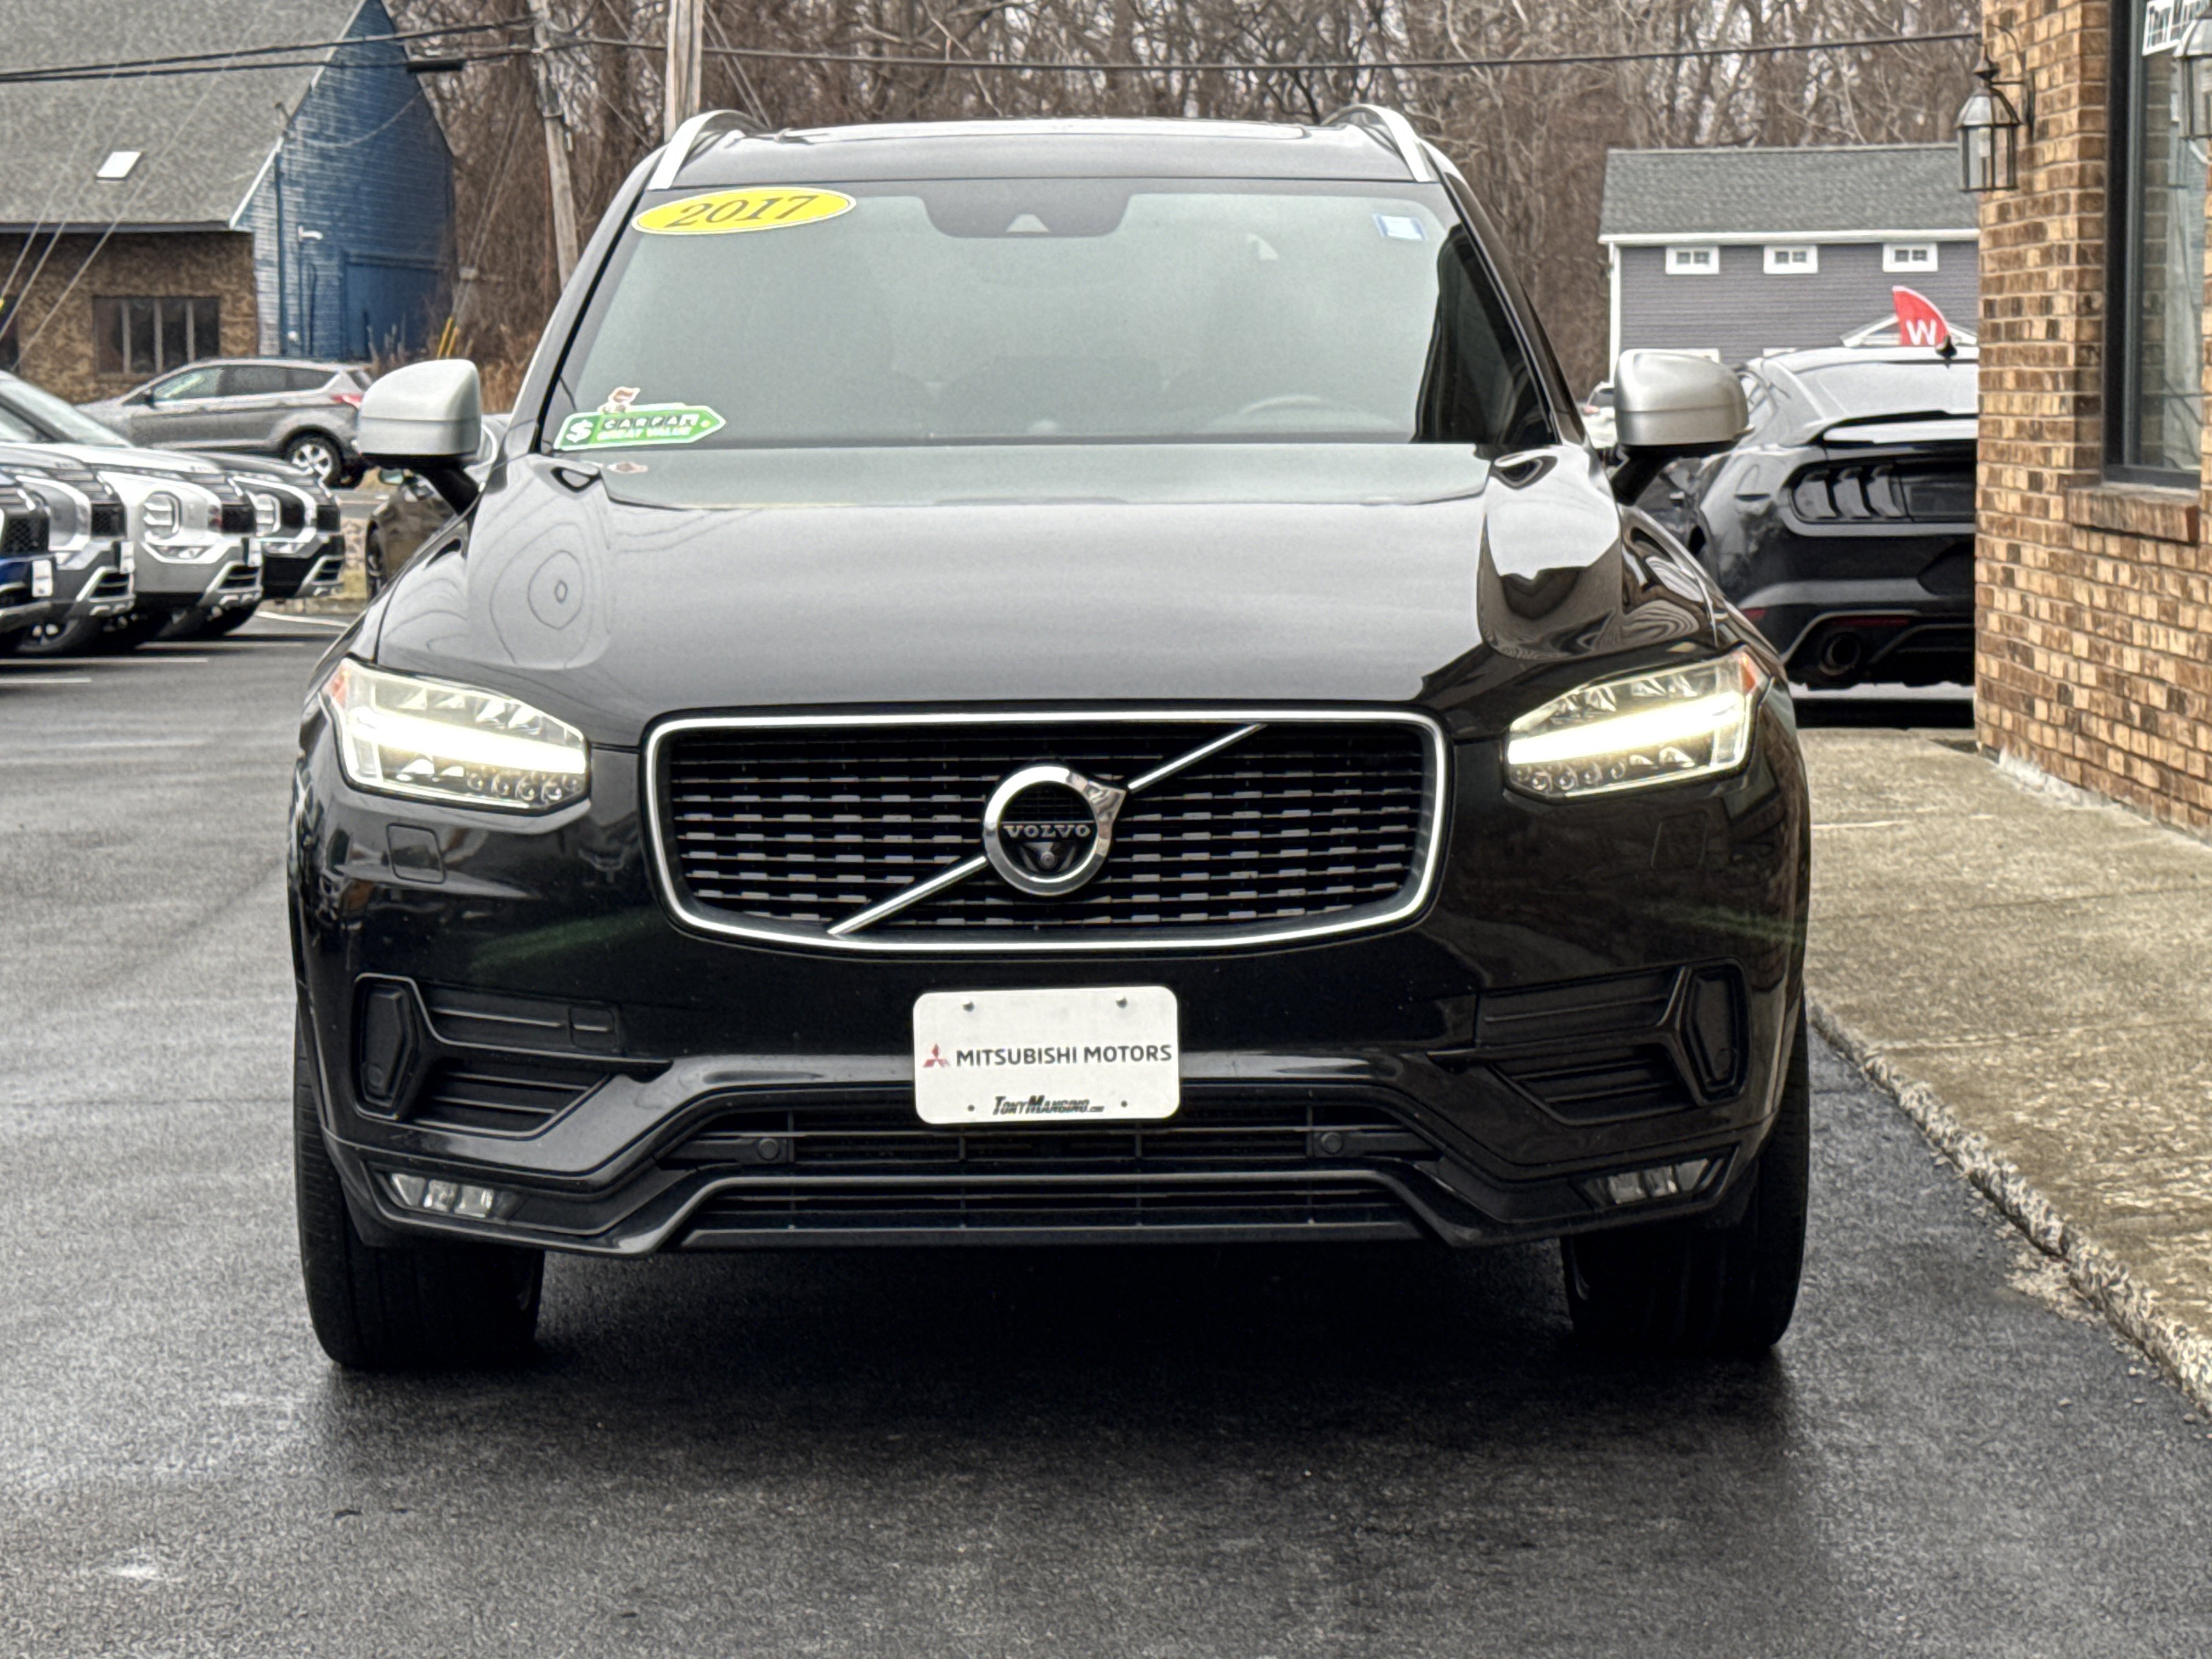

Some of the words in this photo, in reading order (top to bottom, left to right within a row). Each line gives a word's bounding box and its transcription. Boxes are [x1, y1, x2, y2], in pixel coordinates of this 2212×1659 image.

[663, 194, 820, 228] 2017
[1905, 319, 1937, 346] W
[1003, 825, 1091, 838] VOLVO
[956, 1047, 1077, 1066] MITSUBISHI
[1084, 1045, 1172, 1063] MOTORS
